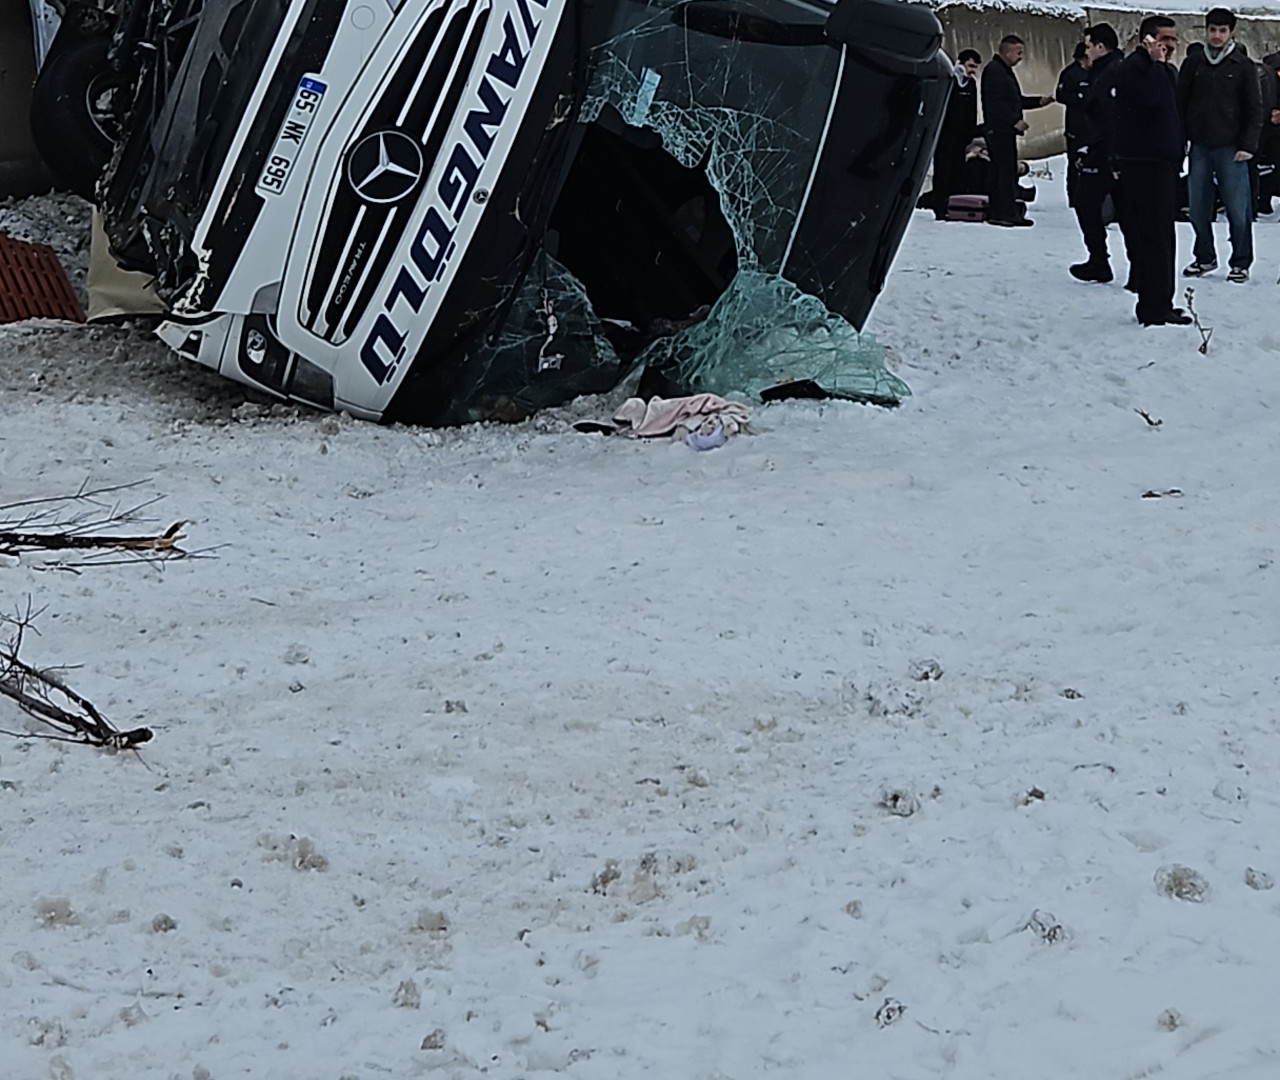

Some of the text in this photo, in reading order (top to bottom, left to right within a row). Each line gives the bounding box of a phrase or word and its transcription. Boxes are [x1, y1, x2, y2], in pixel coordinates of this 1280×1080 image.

[262, 89, 319, 190] 65 NK 695
